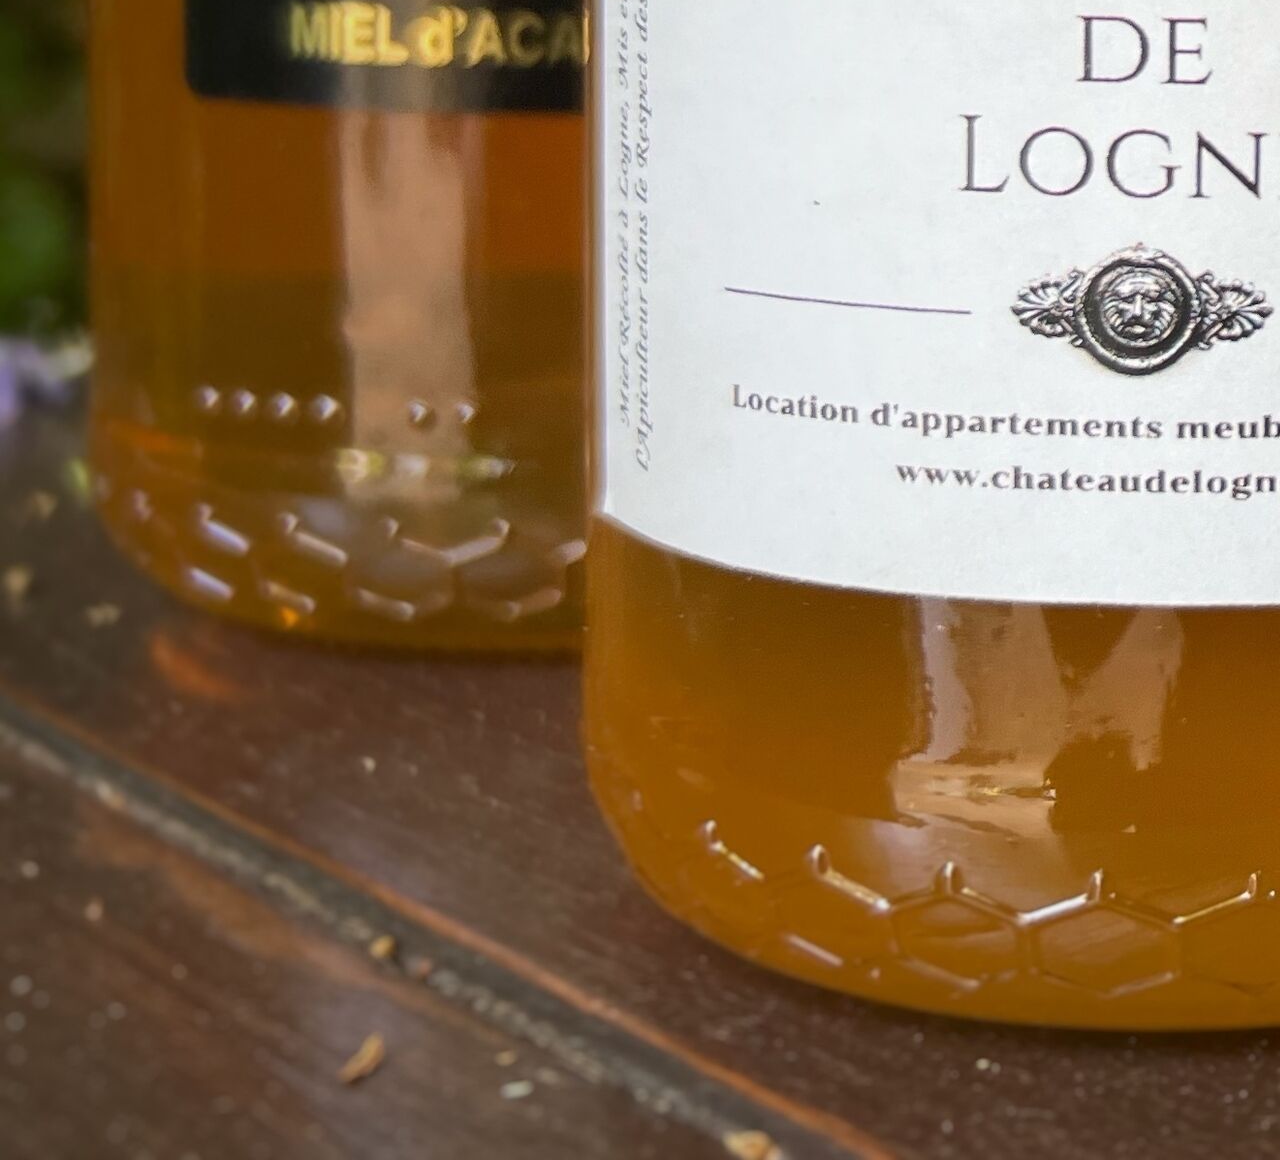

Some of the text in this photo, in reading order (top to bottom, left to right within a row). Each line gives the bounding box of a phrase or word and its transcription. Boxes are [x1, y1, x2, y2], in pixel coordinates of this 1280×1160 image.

[289, 0, 409, 66] MIEL
[617, 27, 629, 90] Mis
[1076, 14, 1213, 85] DE
[636, 54, 652, 169] Respect
[635, 177, 648, 204] le
[635, 213, 649, 286] dans
[618, 345, 631, 427] Miel
[731, 383, 859, 424] Location
[870, 402, 1163, 439] d'appartements
